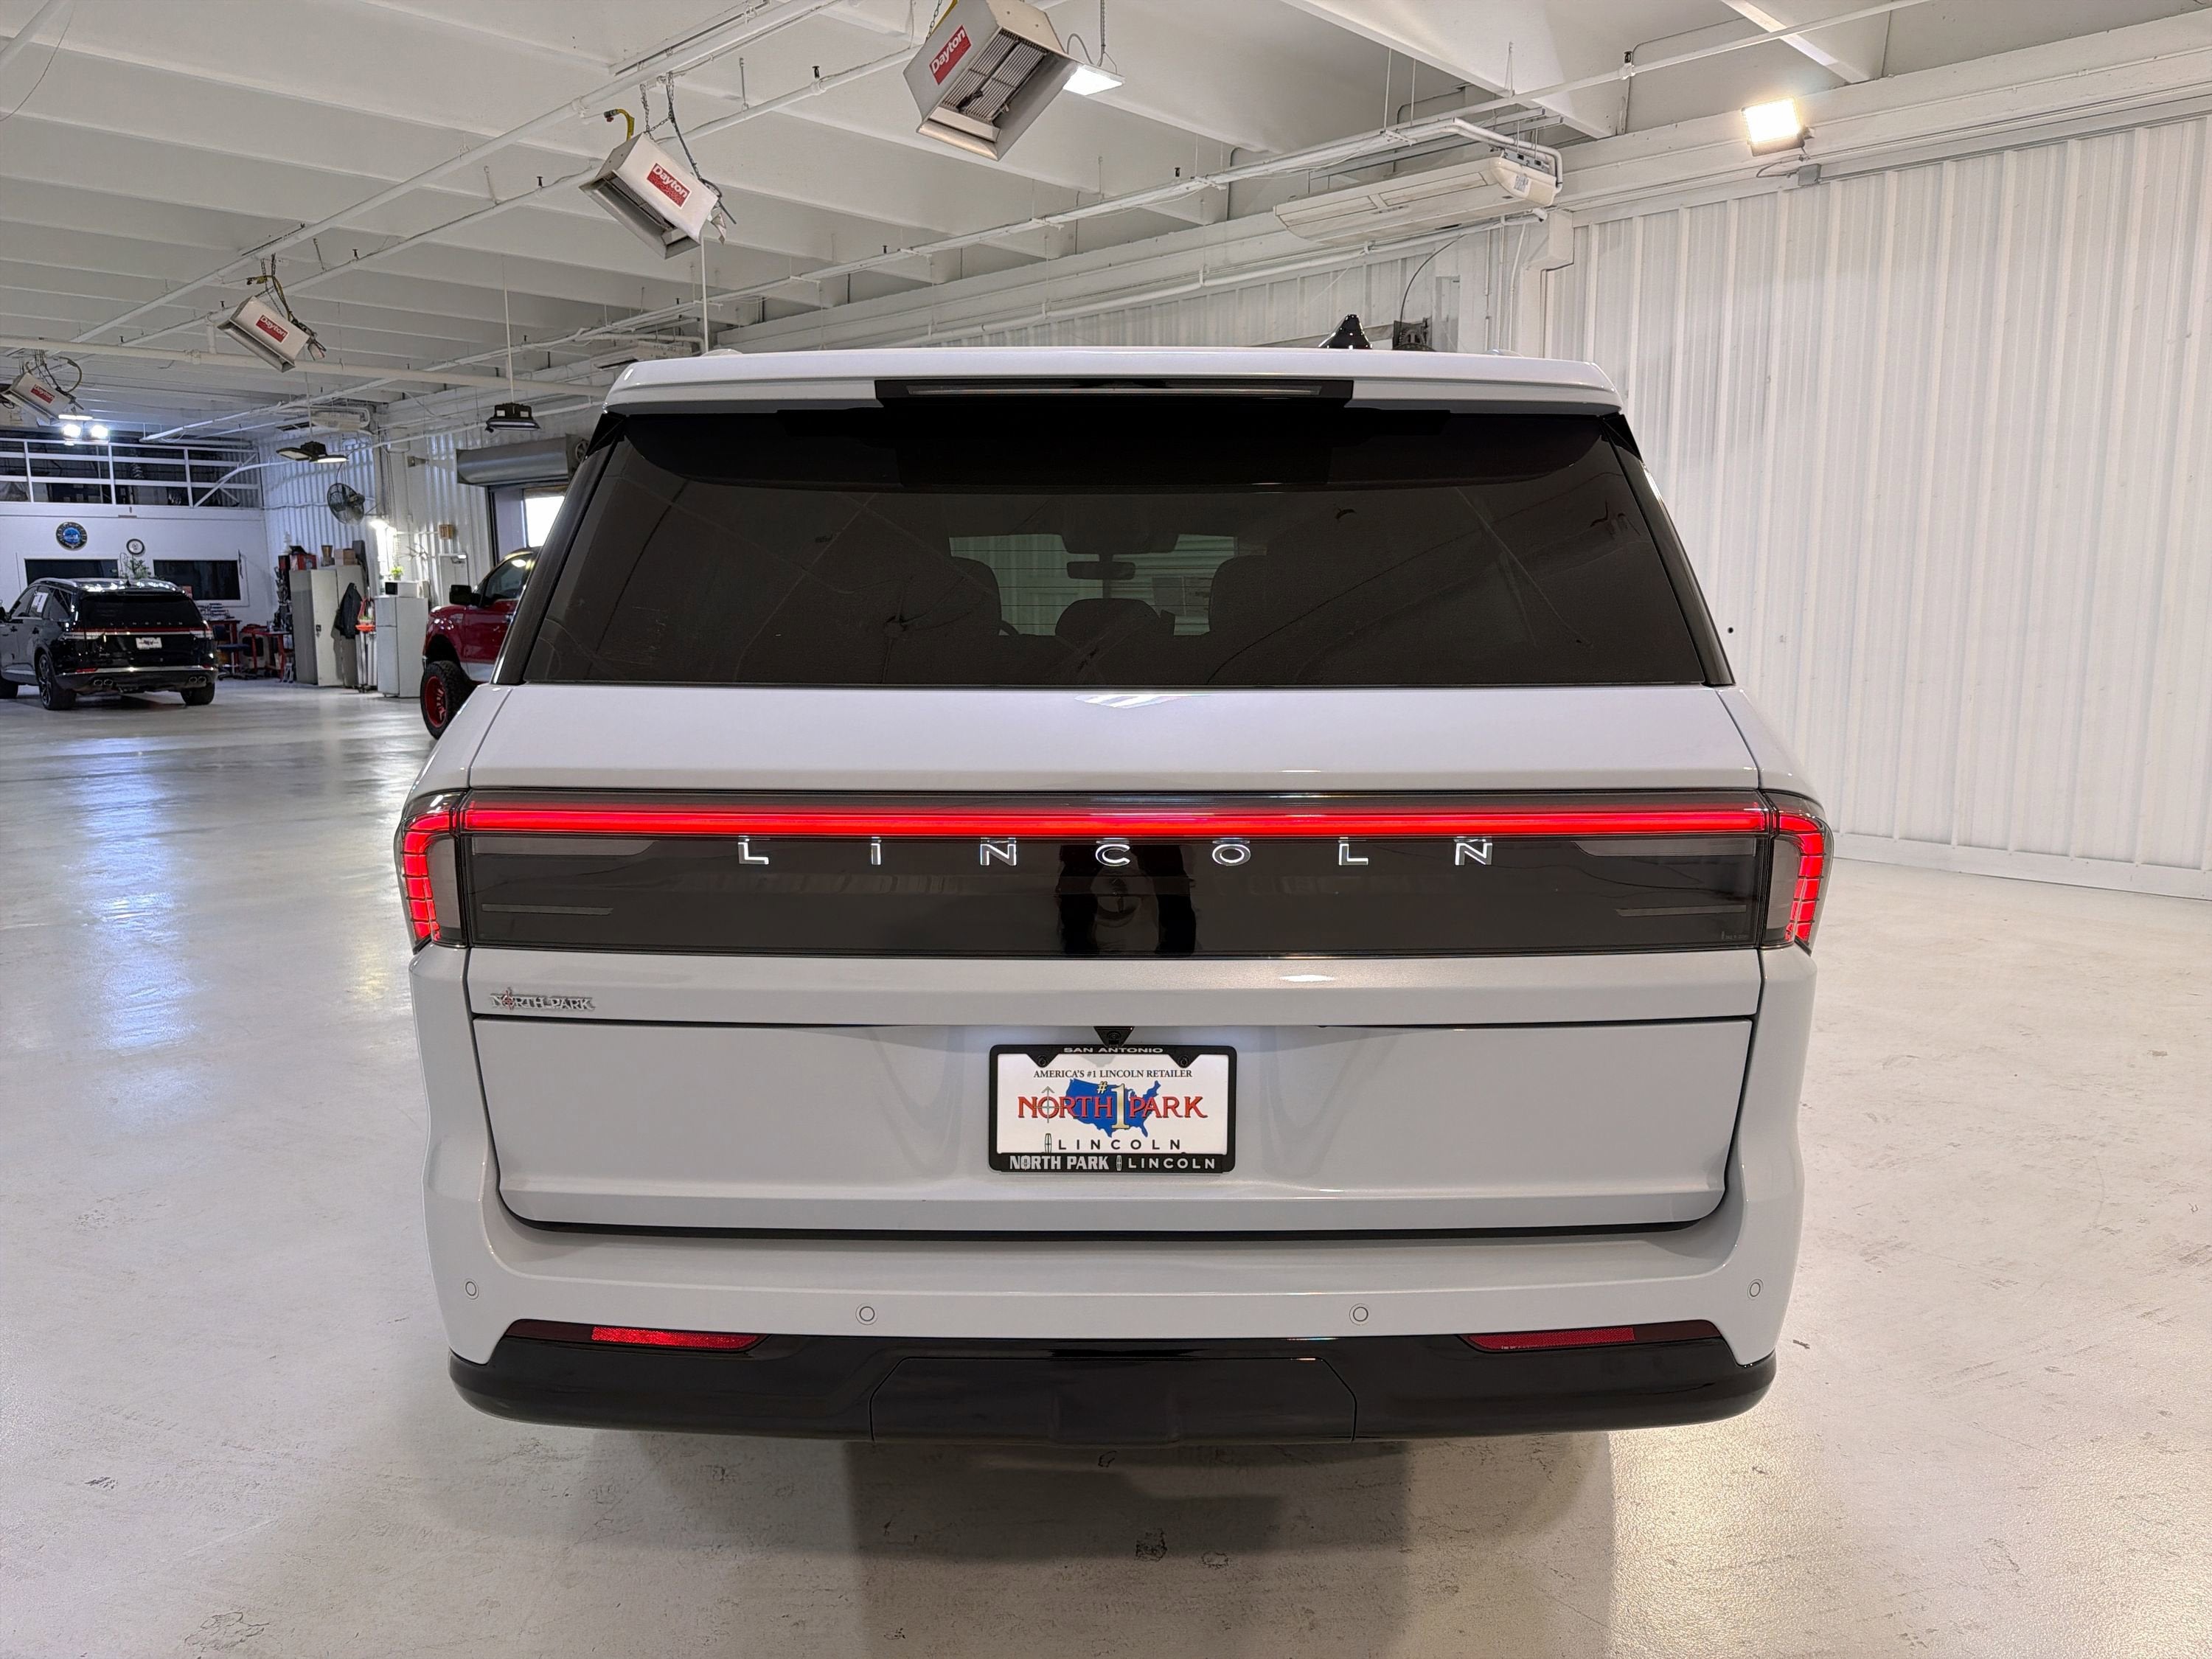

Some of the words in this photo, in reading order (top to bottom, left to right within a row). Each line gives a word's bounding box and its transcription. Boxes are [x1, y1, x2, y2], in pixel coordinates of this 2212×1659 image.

[931, 29, 966, 74] Dayton
[653, 165, 688, 198] Dayton
[260, 316, 287, 337] Dayton
[737, 841, 1493, 866] LINCOLN
[490, 993, 546, 1009] NORTH
[549, 997, 595, 1010] PARK
[1034, 1070, 1085, 1078] AMERICA'S
[1087, 1070, 1097, 1078] #1
[1099, 1070, 1144, 1078] LINCOLN
[1147, 1070, 1193, 1078] RETAILER
[1018, 1096, 1112, 1119] NORTH
[1129, 1096, 1208, 1118] PARK
[1058, 1138, 1181, 1150] LINCOLN
[1009, 1155, 1062, 1170] NORTH
[1066, 1155, 1110, 1170] PARK
[1127, 1157, 1216, 1170] LINCOLN
